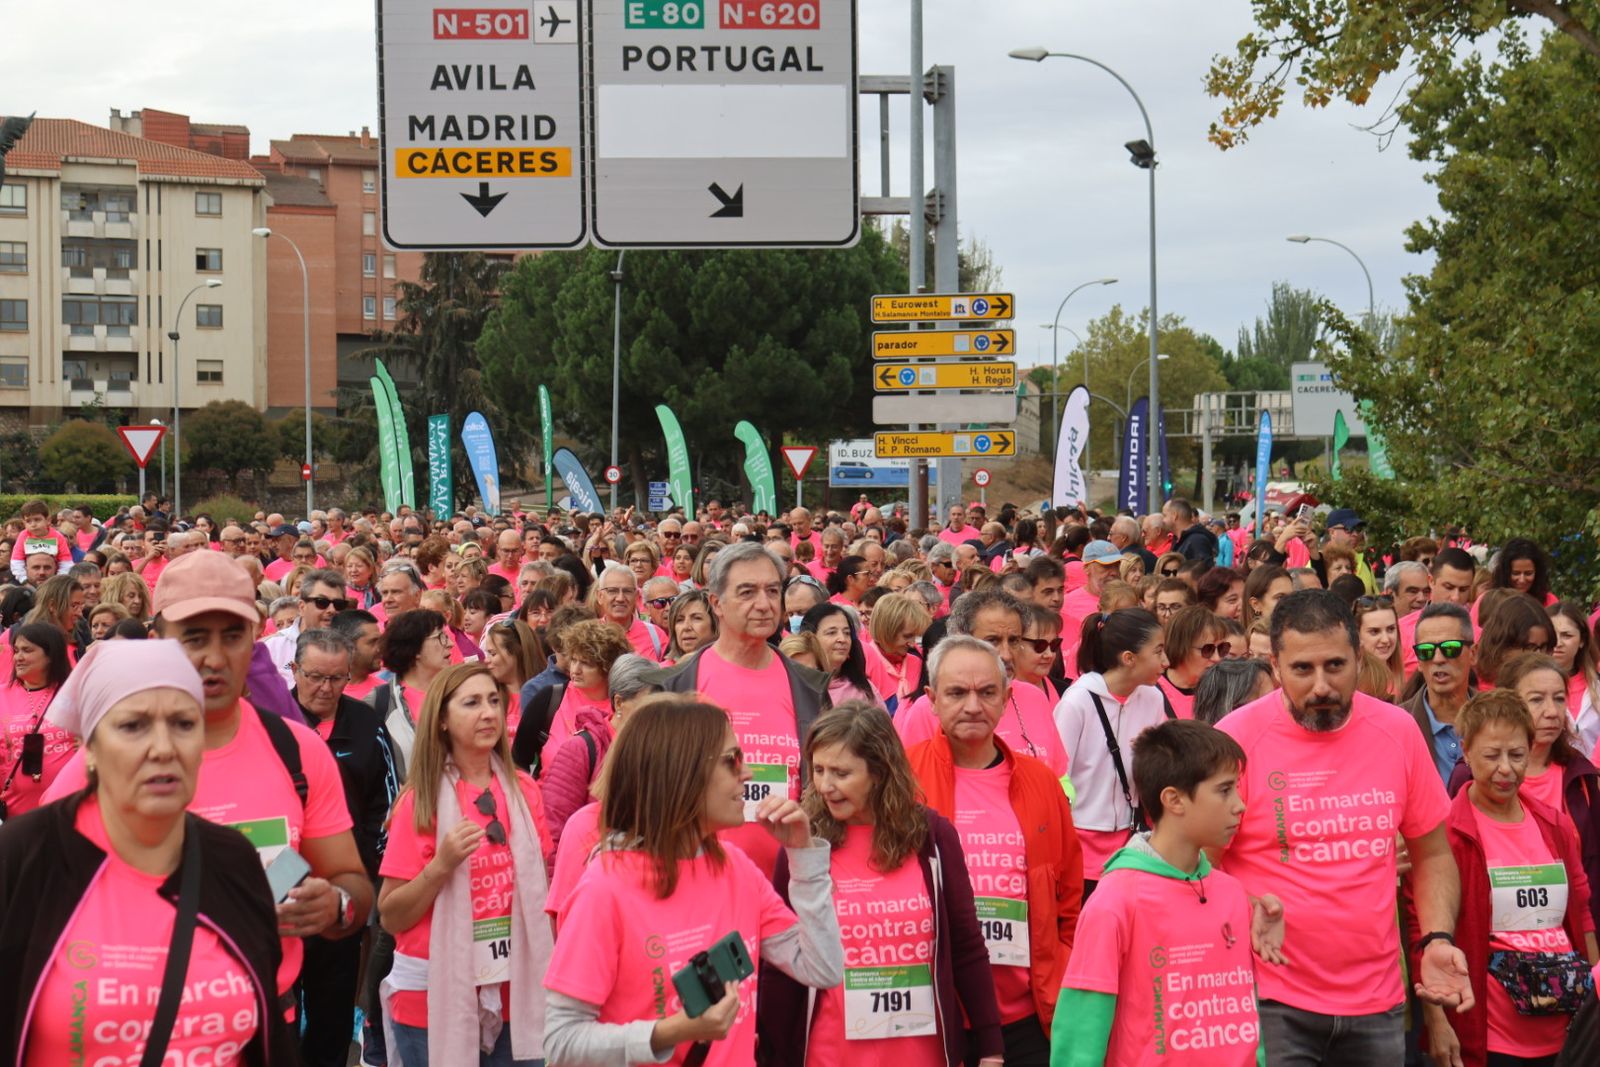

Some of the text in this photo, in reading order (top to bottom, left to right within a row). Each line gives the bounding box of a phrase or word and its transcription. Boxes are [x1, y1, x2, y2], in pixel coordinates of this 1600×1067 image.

[436, 9, 527, 35] N-501
[629, 1, 699, 25] E-80
[722, 1, 817, 25] N-620
[622, 45, 824, 72] PORTUGAL
[430, 64, 536, 90] AVILA
[408, 115, 557, 141] MADRID
[407, 147, 558, 174] CÁCERES
[891, 299, 938, 308] Eurowest
[877, 340, 918, 351] parador
[969, 366, 1011, 375] H. Horus
[972, 376, 1011, 385] H. Regio
[878, 436, 918, 445] H. Vincci
[878, 445, 941, 454] H. P. Romano
[852, 449, 873, 458] BUZ
[1288, 787, 1396, 812] En marcha
[1274, 797, 1289, 862] SALAMANCA
[1290, 809, 1394, 837] contra el
[967, 831, 1025, 847] march
[1294, 837, 1391, 862] cáncer
[837, 899, 861, 916] En
[1516, 887, 1549, 908] 603
[840, 917, 917, 939] contra
[1167, 966, 1254, 992] En marcha
[97, 978, 139, 1006] En
[870, 989, 912, 1013] 7191
[232, 996, 258, 1032] el
[1153, 976, 1166, 1055] SALAMANCA
[1168, 990, 1257, 1020] contra el
